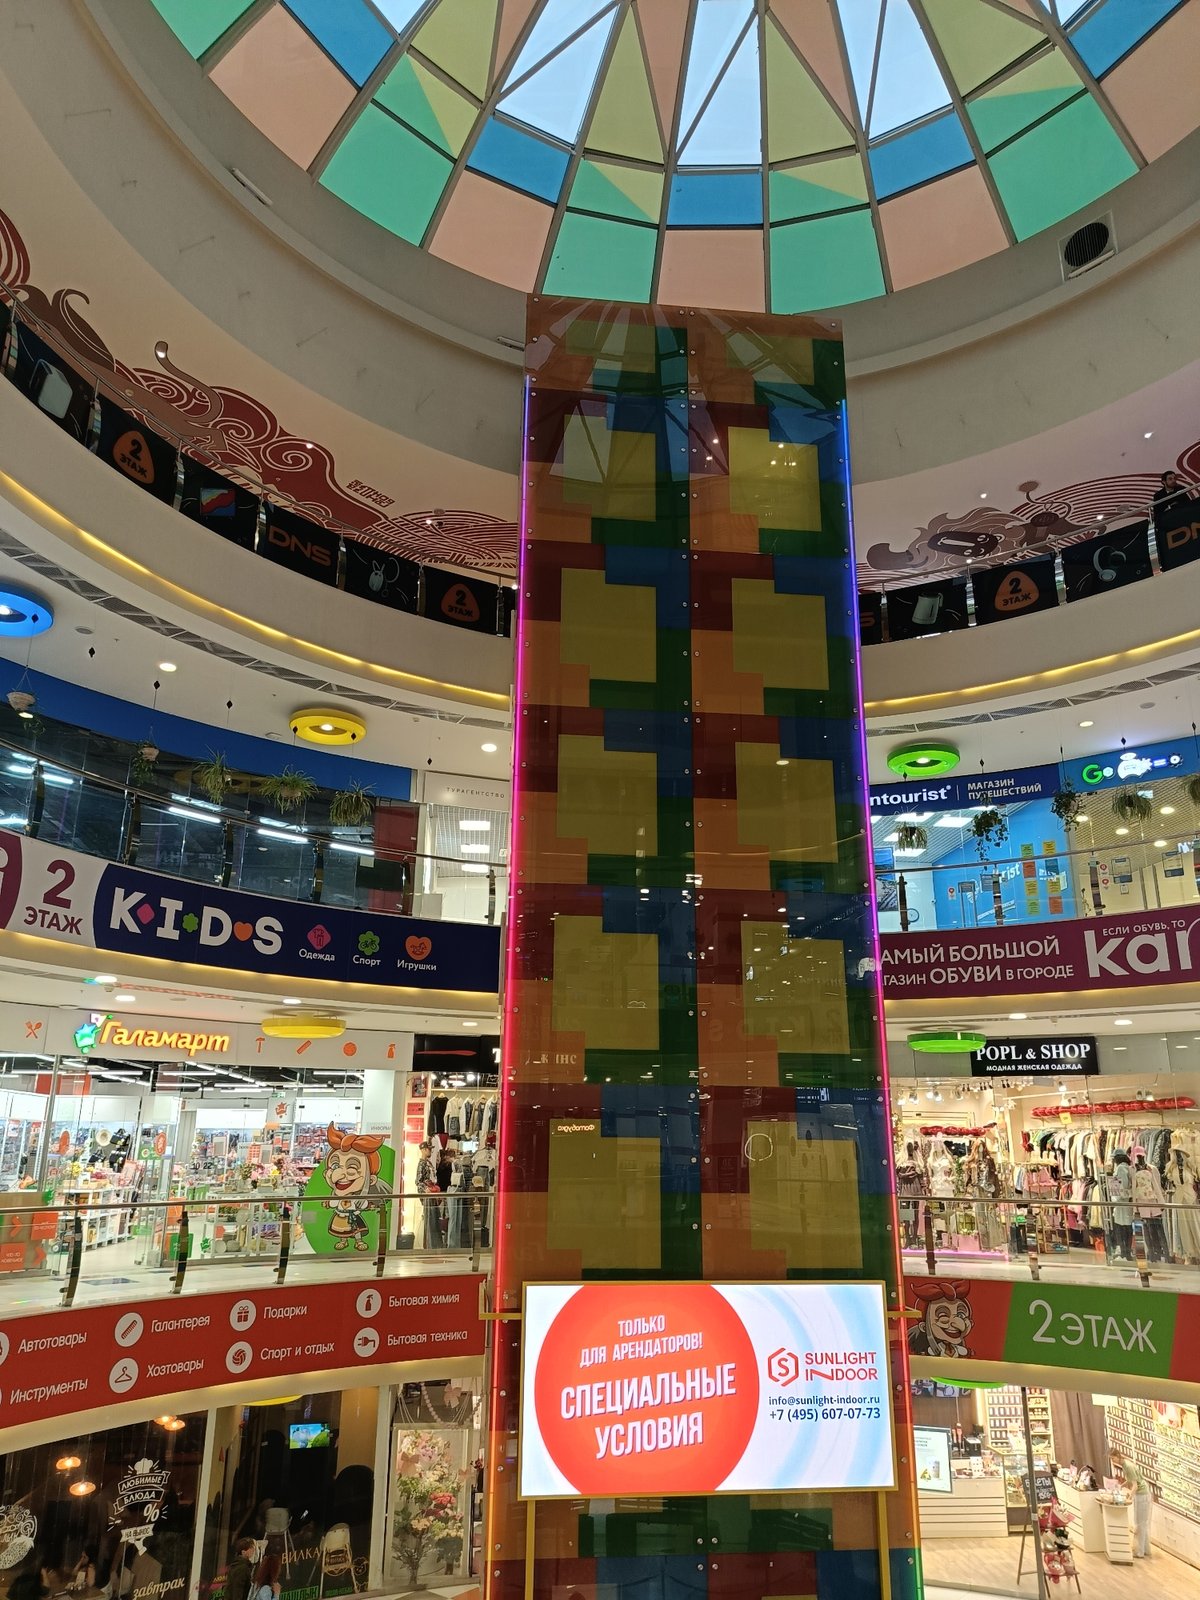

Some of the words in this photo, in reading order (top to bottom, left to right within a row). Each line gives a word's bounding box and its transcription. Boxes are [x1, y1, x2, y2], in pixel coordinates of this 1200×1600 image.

[129, 438, 143, 461] 2
[119, 453, 148, 479] ЭТАЖ
[268, 525, 332, 567] DNS
[1008, 577, 1022, 595] 2
[455, 590, 467, 607] 2
[1001, 592, 1032, 607] ЭТАЖ
[447, 605, 474, 618] ЭТАЖ
[446, 787, 505, 799] ТУРАГЕНТСТВО
[967, 778, 1015, 791] МАГАЗИН
[967, 783, 1042, 800] ПУТЕШЕСТВИЙ
[870, 788, 948, 806] ntourist
[43, 859, 76, 909] 2
[23, 905, 84, 936] ЭТАЖ
[109, 886, 284, 955] KIDS
[1103, 924, 1130, 937] ЕСЛИ
[1133, 921, 1170, 934] ОБУВЬ,
[1170, 919, 1186, 929] ТО
[298, 948, 336, 962] Одежда
[881, 943, 946, 966] АМЫЙ
[948, 935, 1060, 963] БОЛЬШОЙ
[352, 954, 381, 968] Спорт
[397, 959, 437, 972] Игрушки
[882, 973, 927, 987] ГАЗИН
[929, 964, 1002, 985] ОБУВИ
[1006, 969, 1015, 981] В
[1016, 964, 1075, 981] ГОРОДЕ
[98, 1020, 230, 1057] Галамарт
[976, 1045, 1022, 1061] POPL
[1025, 1048, 1037, 1060] &
[1040, 1043, 1091, 1060] SHOP
[986, 1064, 1016, 1072] МОДНАЯ
[1016, 1063, 1050, 1071] ЖЕНСКАЯ
[1050, 1063, 1083, 1071] ОДЕЖДА
[388, 1295, 429, 1308] Бытовая
[431, 1293, 460, 1305] химия
[263, 1305, 308, 1319] Подарки
[151, 1314, 211, 1333] Галантерея
[618, 1315, 666, 1338] ТОЛЬКО
[1028, 1299, 1056, 1344] 2
[387, 1332, 428, 1346] Бытовая
[430, 1330, 468, 1344] техника
[1060, 1312, 1157, 1354] ЭТАЖ
[17, 1331, 88, 1354] Автотовары
[260, 1345, 292, 1361] Спорт
[295, 1345, 302, 1355] и
[304, 1341, 335, 1356] отдых
[579, 1345, 607, 1368] ДЛЯ
[612, 1332, 703, 1362] АРЕНДАТОРОВ!
[804, 1351, 877, 1366] SUNLIGHT
[146, 1358, 204, 1379] Хозтовары
[804, 1368, 879, 1381] INDOOR
[9, 1378, 89, 1405] Инструменты
[560, 1363, 737, 1420] СПЕЦИАЛЬНЫЕ
[768, 1395, 880, 1407] info@sunlight-indoor.ru
[769, 1408, 785, 1421] +7
[787, 1408, 819, 1423] (495)
[821, 1407, 881, 1420] 607-07-73
[595, 1411, 704, 1460] УСЛОВИЯ
[121, 1476, 163, 1492] ЛЮБИМЫЕ
[123, 1490, 156, 1505] БЛЮДА
[132, 1576, 186, 1600] завтрак
